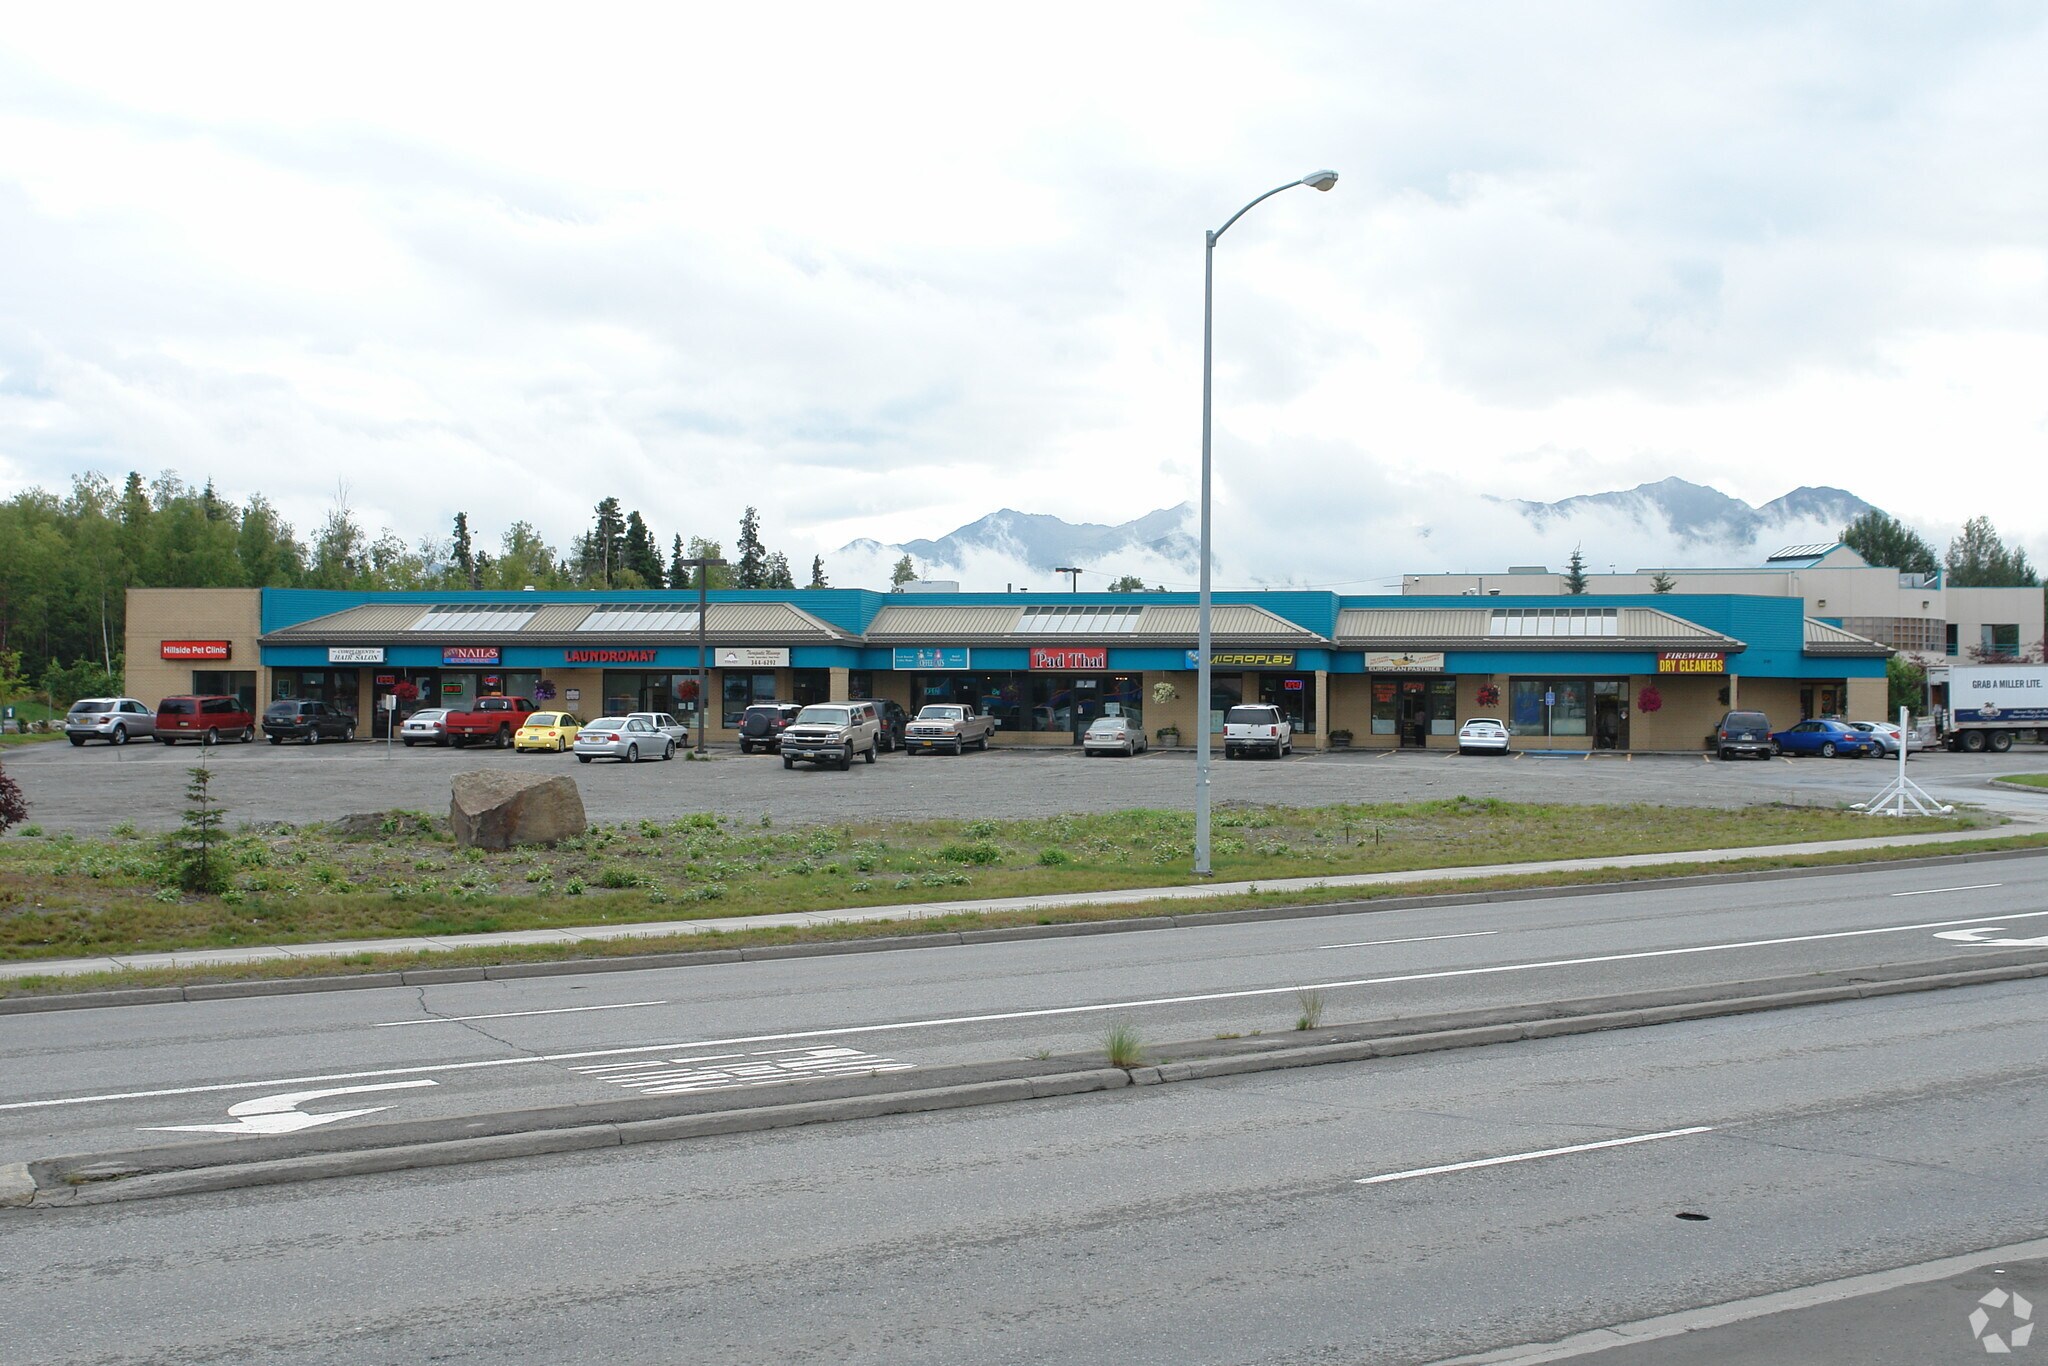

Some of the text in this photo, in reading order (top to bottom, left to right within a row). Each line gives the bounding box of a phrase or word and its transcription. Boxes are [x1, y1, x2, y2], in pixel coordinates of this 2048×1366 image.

[163, 646, 227, 654] Hillside Pet Clinic
[458, 648, 498, 658] NAILS
[564, 649, 657, 662] LAUNDROMAT
[1034, 652, 1105, 669] Pad Thai
[1659, 659, 1724, 672] DRY CLEANERS
[1972, 679, 2043, 689] GRAB A MILLER LITE.
